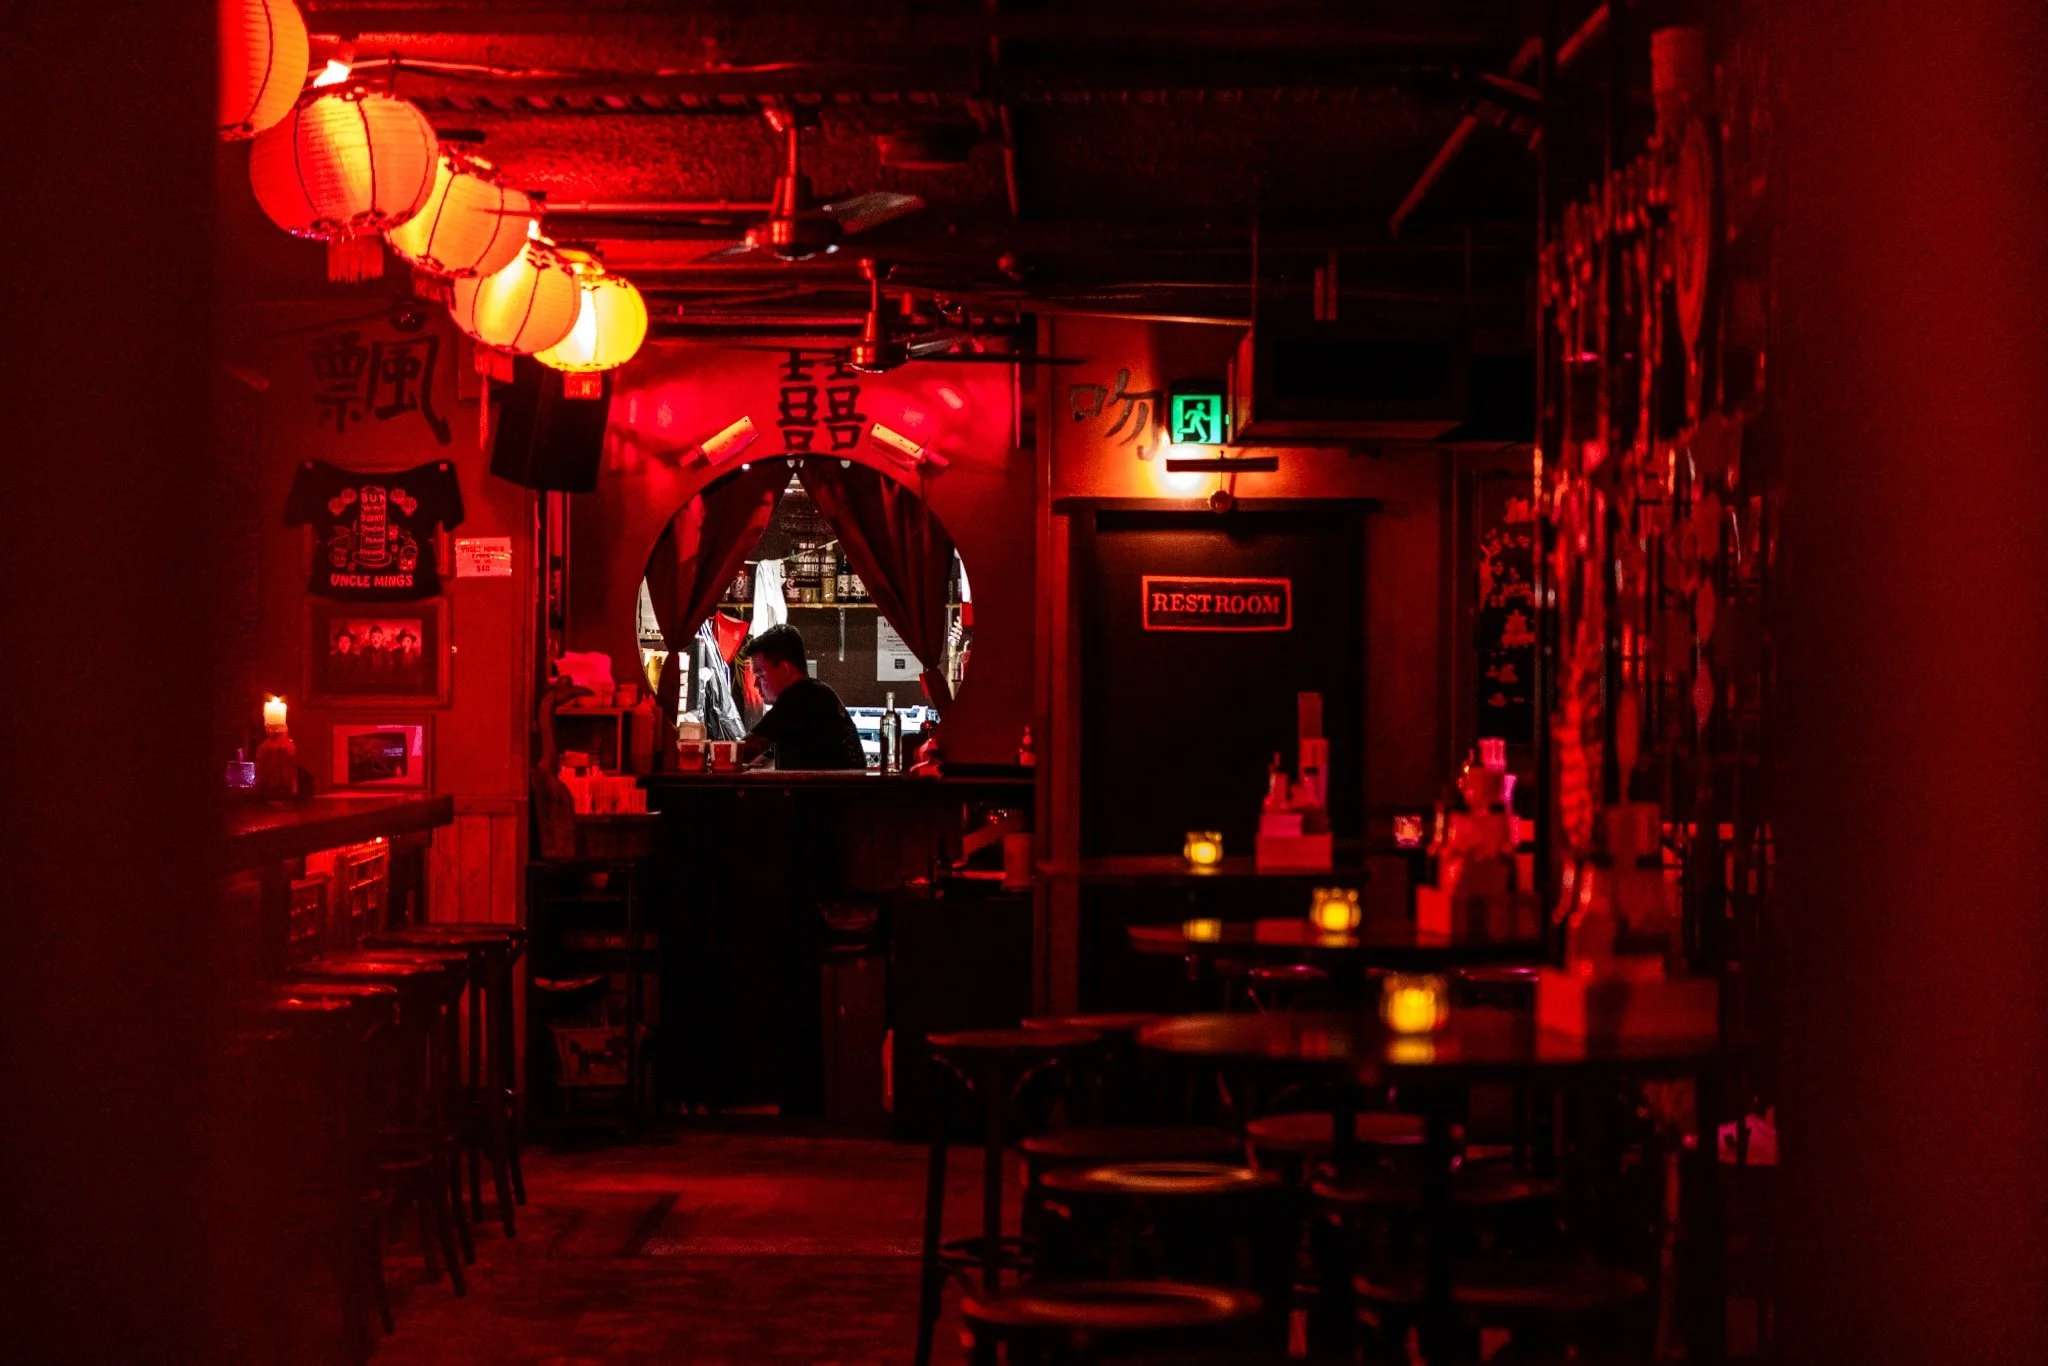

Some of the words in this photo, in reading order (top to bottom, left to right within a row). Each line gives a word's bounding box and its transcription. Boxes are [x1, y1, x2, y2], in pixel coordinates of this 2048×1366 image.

[330, 573, 371, 588] UNCLE
[373, 574, 414, 588] MINGS
[1151, 592, 1281, 615] RESTROOM
